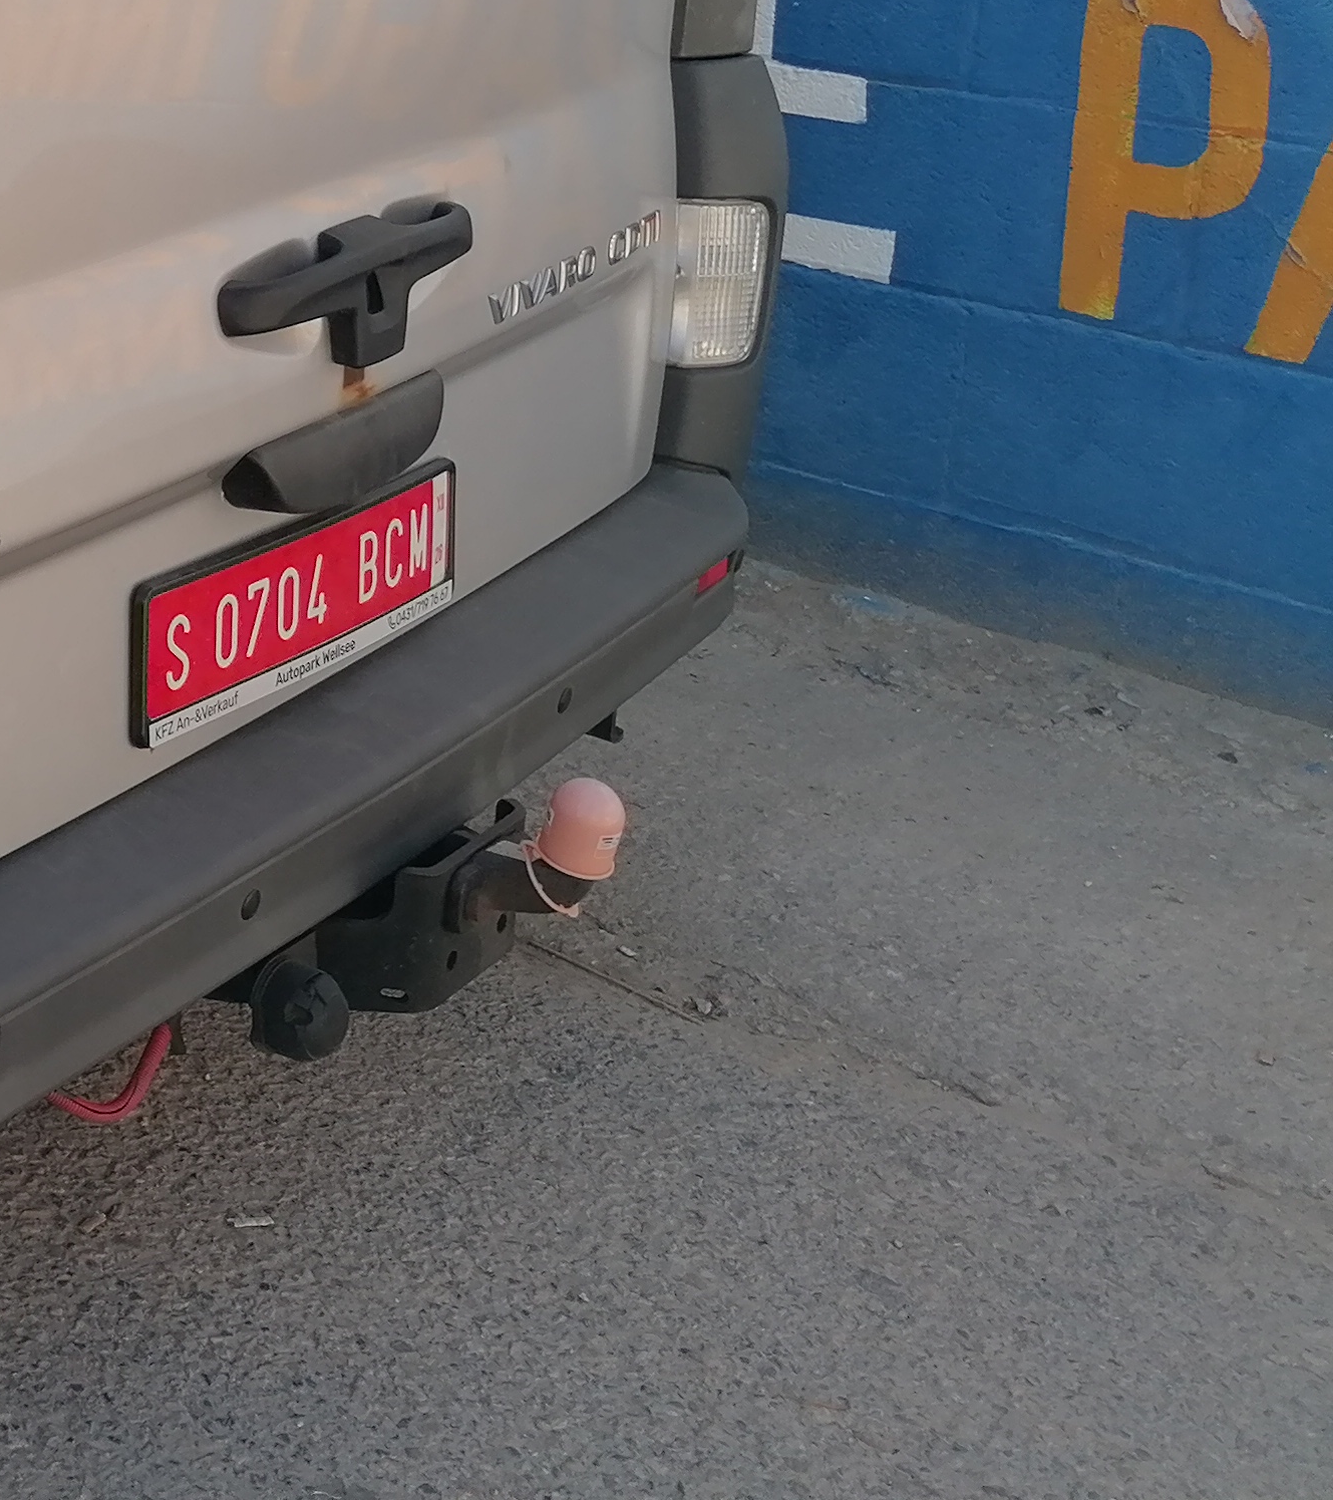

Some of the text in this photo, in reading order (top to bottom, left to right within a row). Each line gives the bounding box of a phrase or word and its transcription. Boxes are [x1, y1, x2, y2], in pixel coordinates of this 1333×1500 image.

[488, 245, 596, 325] VIVARO
[165, 502, 429, 692] S 0704 BCM
[275, 639, 356, 687] Autopark Wellsee
[154, 722, 175, 742] KFZ
